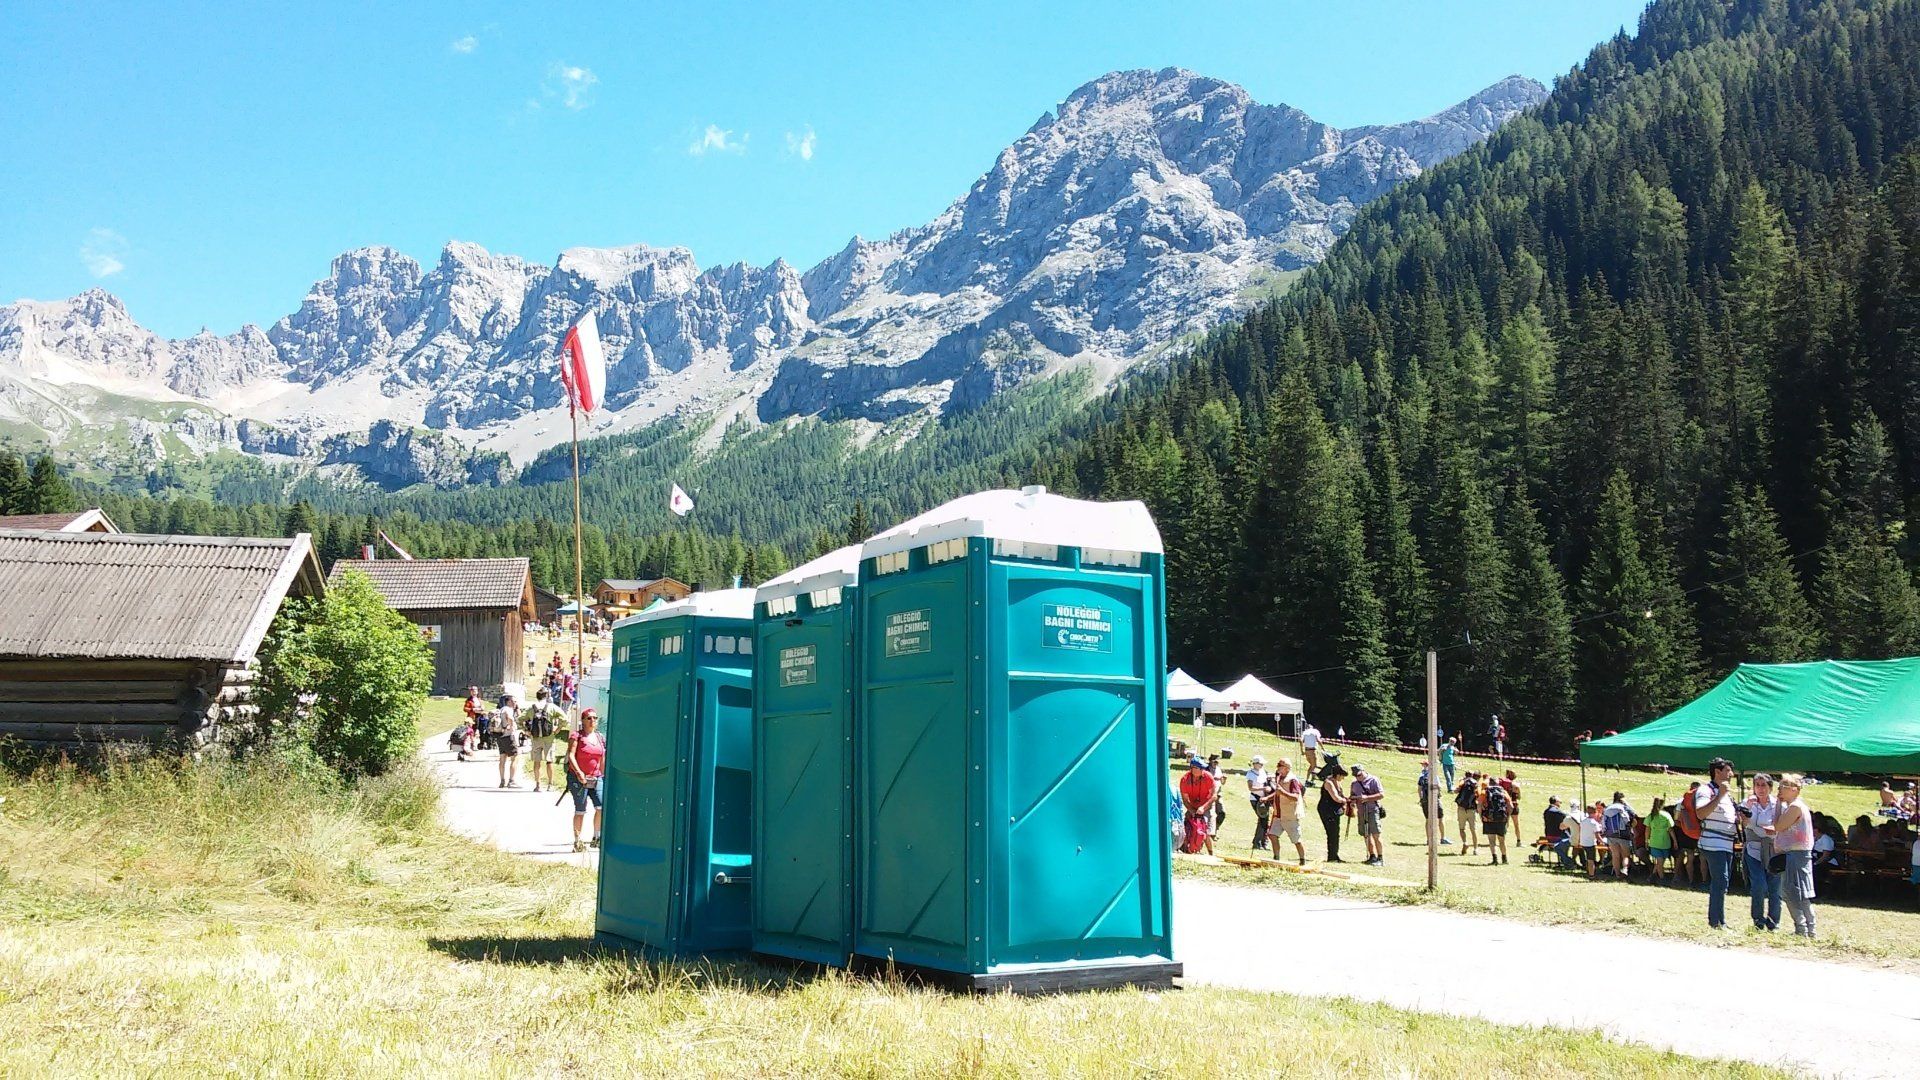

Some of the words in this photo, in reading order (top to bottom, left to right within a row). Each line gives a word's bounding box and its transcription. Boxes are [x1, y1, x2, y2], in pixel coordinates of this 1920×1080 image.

[893, 611, 921, 625] NOLEGGIO
[1056, 606, 1101, 620] NOLEGGIO
[887, 624, 904, 637] BAGNI
[904, 621, 929, 634] CHIMICI
[1045, 616, 1074, 628] BAGNI
[1077, 619, 1111, 632] CHIMICI
